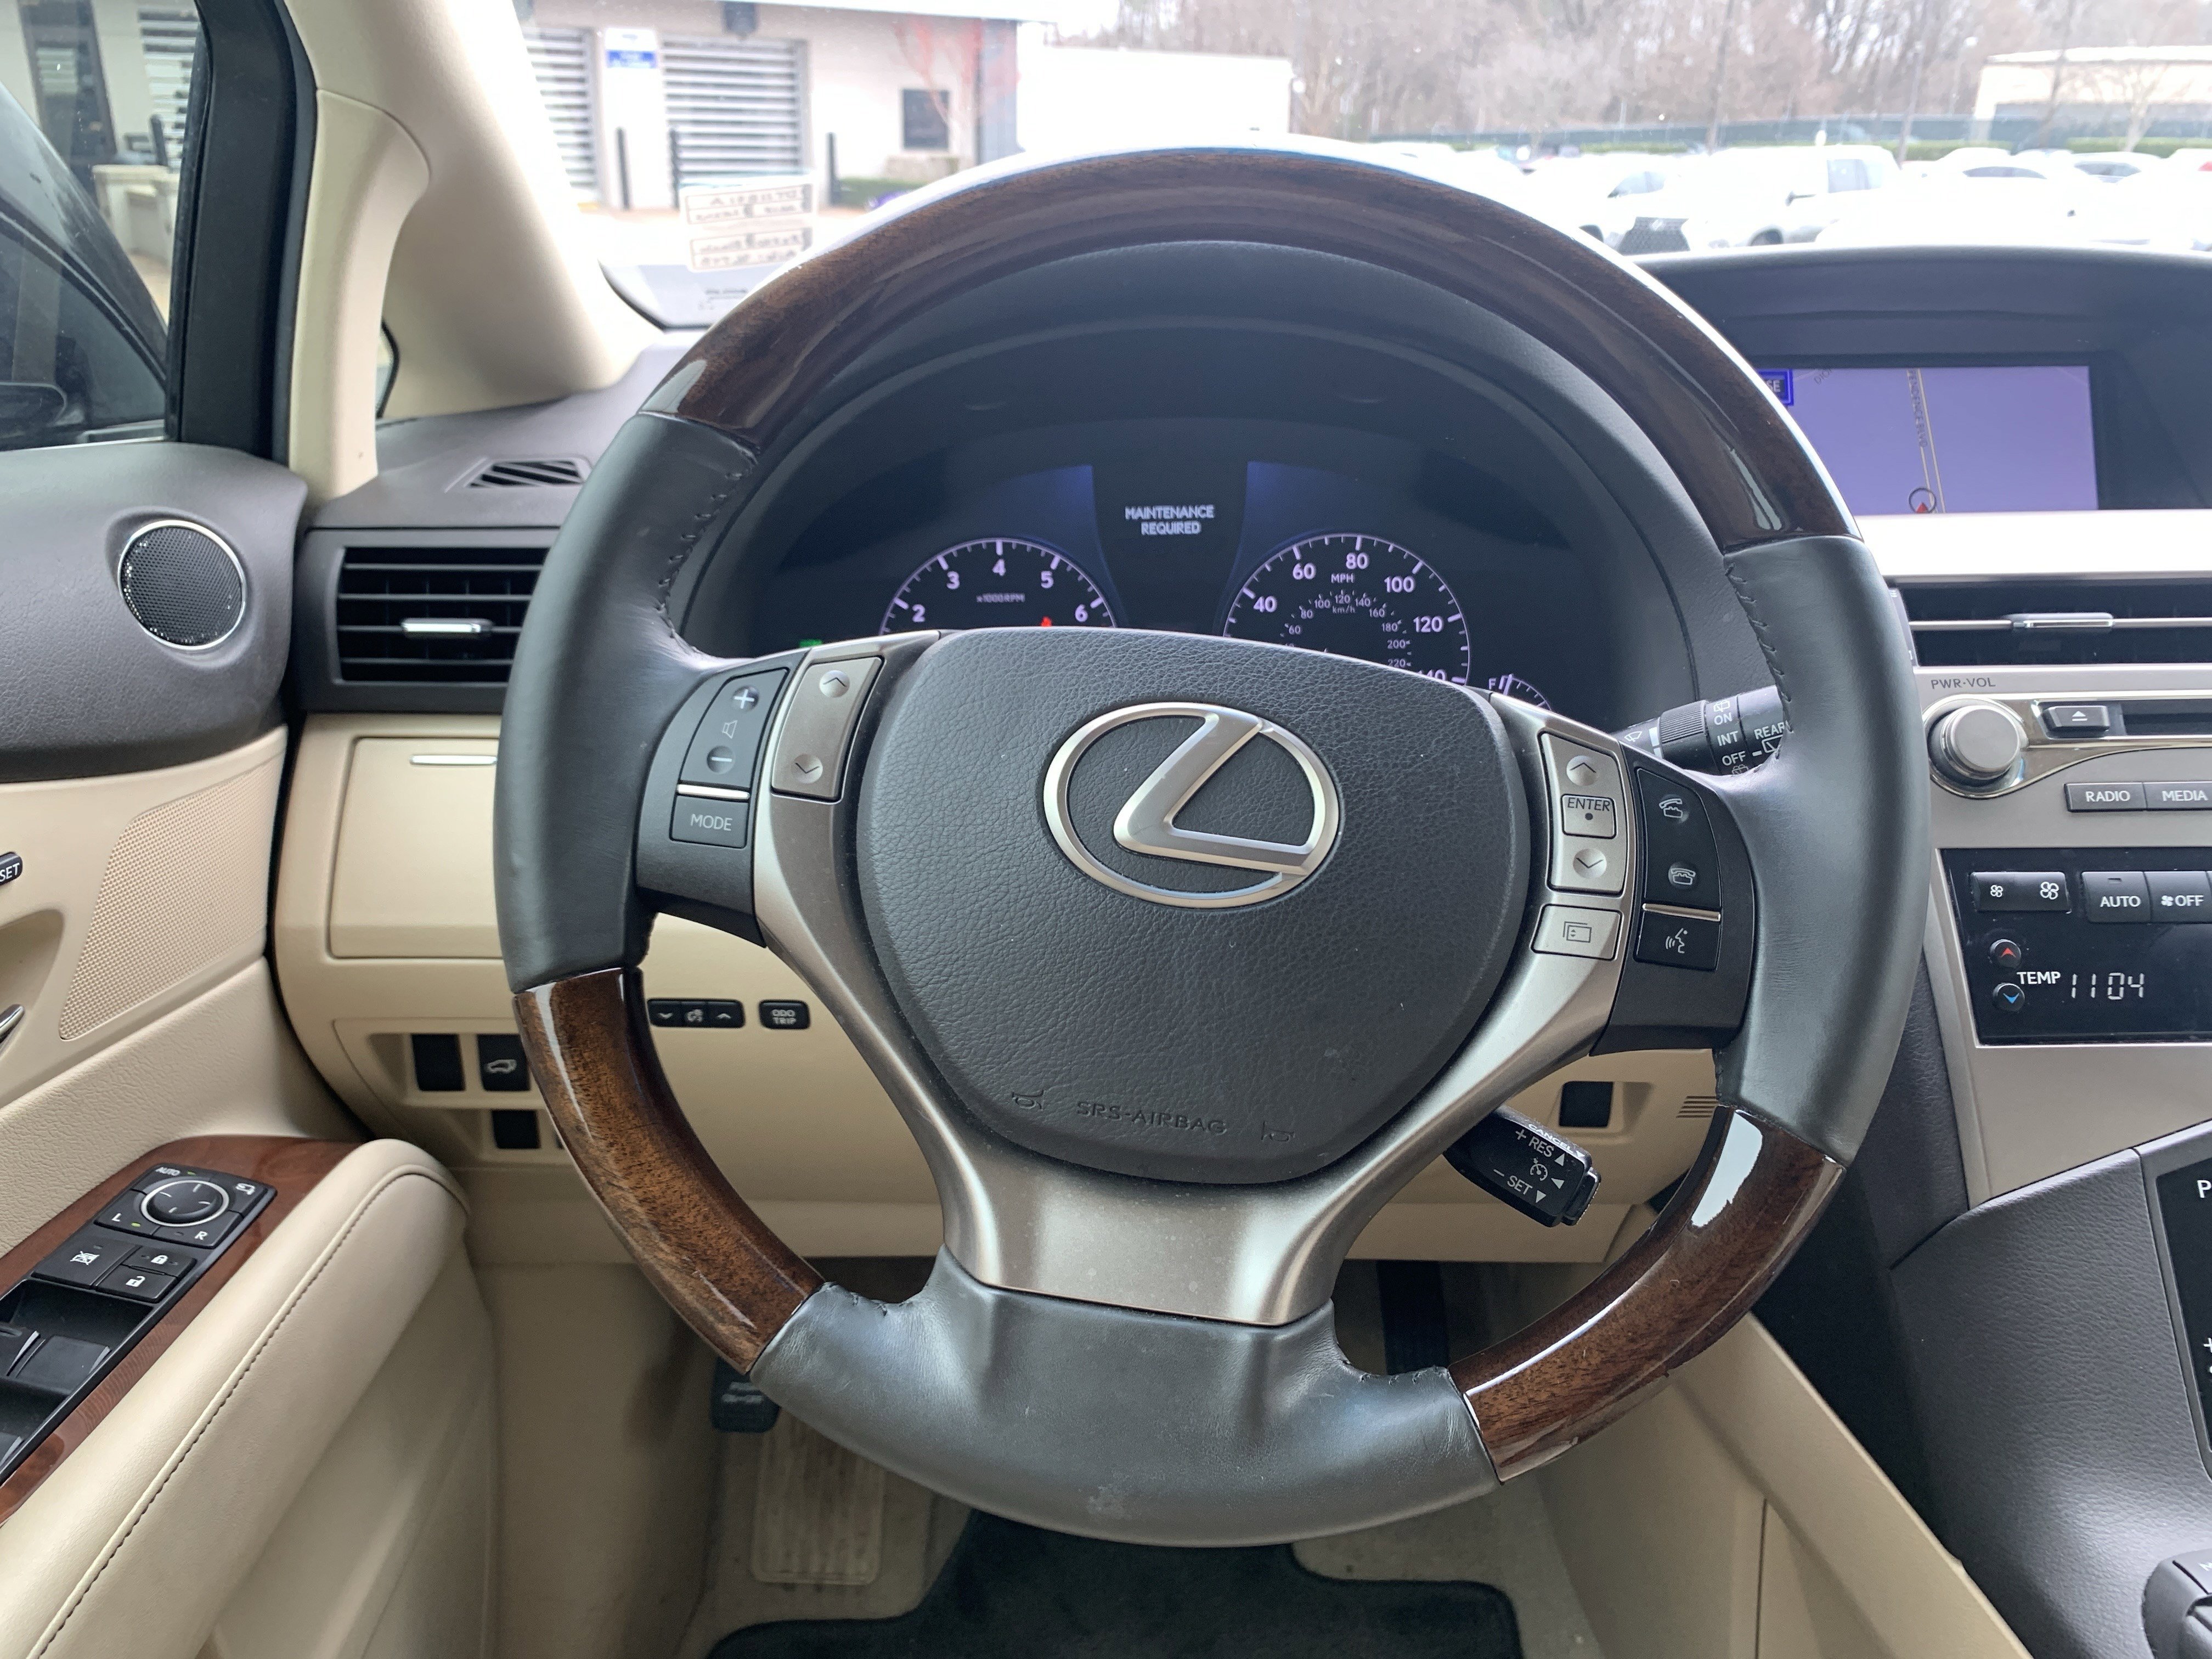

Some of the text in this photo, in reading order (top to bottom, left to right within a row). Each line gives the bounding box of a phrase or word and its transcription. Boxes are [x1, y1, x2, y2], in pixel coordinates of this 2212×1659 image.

[1125, 505, 1215, 520] MAINTENANCE
[1141, 521, 1201, 535] REQUIRED
[992, 559, 1006, 575] 4
[1346, 552, 1368, 569] 80
[1293, 563, 1316, 580] 60
[1331, 573, 1355, 583] MPH
[947, 572, 960, 589] 3
[1041, 571, 1053, 589] 5
[1384, 576, 1415, 592] 100
[1254, 596, 1277, 612] 40
[1314, 599, 1330, 608] 100
[1334, 594, 1350, 604] 120
[1355, 597, 1370, 607] 140
[912, 605, 926, 623] 2
[1075, 605, 1088, 622] 6
[1301, 609, 1313, 618] 80
[1333, 605, 1355, 614] km/h
[1369, 608, 1385, 618] 160
[1289, 625, 1301, 635] 60
[1381, 622, 1397, 632] 180
[1413, 616, 1443, 632] 120
[1387, 639, 1406, 649] 200
[1388, 658, 1406, 668] 220
[1489, 678, 1496, 690] F
[1714, 713, 1732, 725] ON
[1717, 731, 1738, 746] INT
[1722, 751, 1746, 766] OFF
[2085, 790, 2131, 803] RADIO
[2162, 789, 2208, 802] MEDIA
[1567, 798, 1611, 811] ENTER
[691, 814, 733, 832] MODE
[2100, 895, 2141, 908] AUTO
[2175, 894, 2204, 907] OFF
[2017, 971, 2061, 985] TEMP
[1076, 1101, 1227, 1135] SRS-AIRBAG
[1528, 1124, 1573, 1153] CANCEL
[1528, 1136, 1554, 1158] RES
[155, 1166, 180, 1176] AUTO
[1507, 1175, 1533, 1195] SET
[112, 1212, 122, 1223] L
[195, 1230, 207, 1241] R
